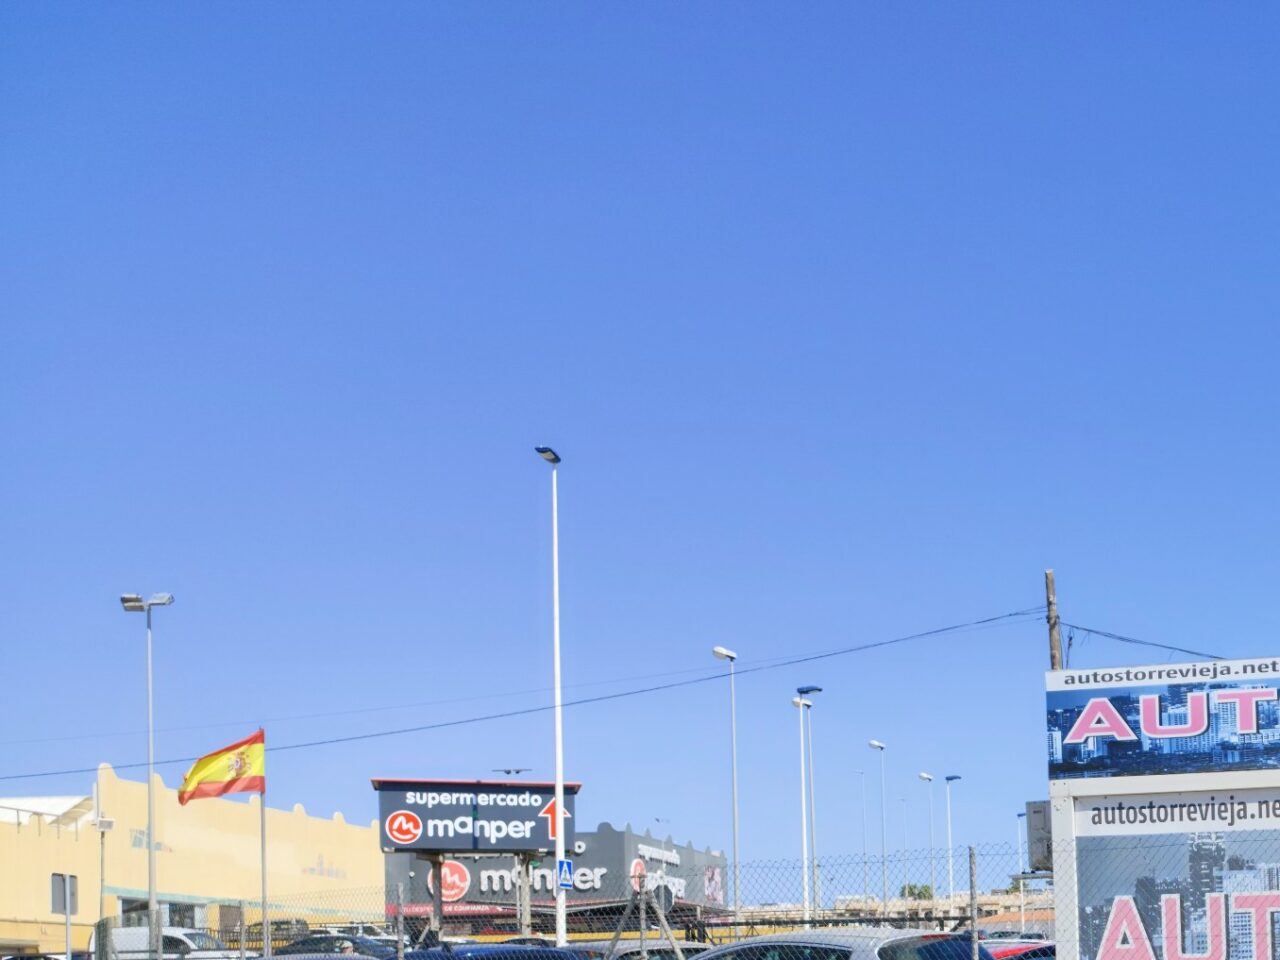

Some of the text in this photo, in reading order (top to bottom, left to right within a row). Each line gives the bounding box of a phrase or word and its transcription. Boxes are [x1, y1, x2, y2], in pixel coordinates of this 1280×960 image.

[1064, 660, 1280, 686] autostorrevieja.net
[405, 791, 543, 808] supermercado
[427, 816, 536, 844] manper
